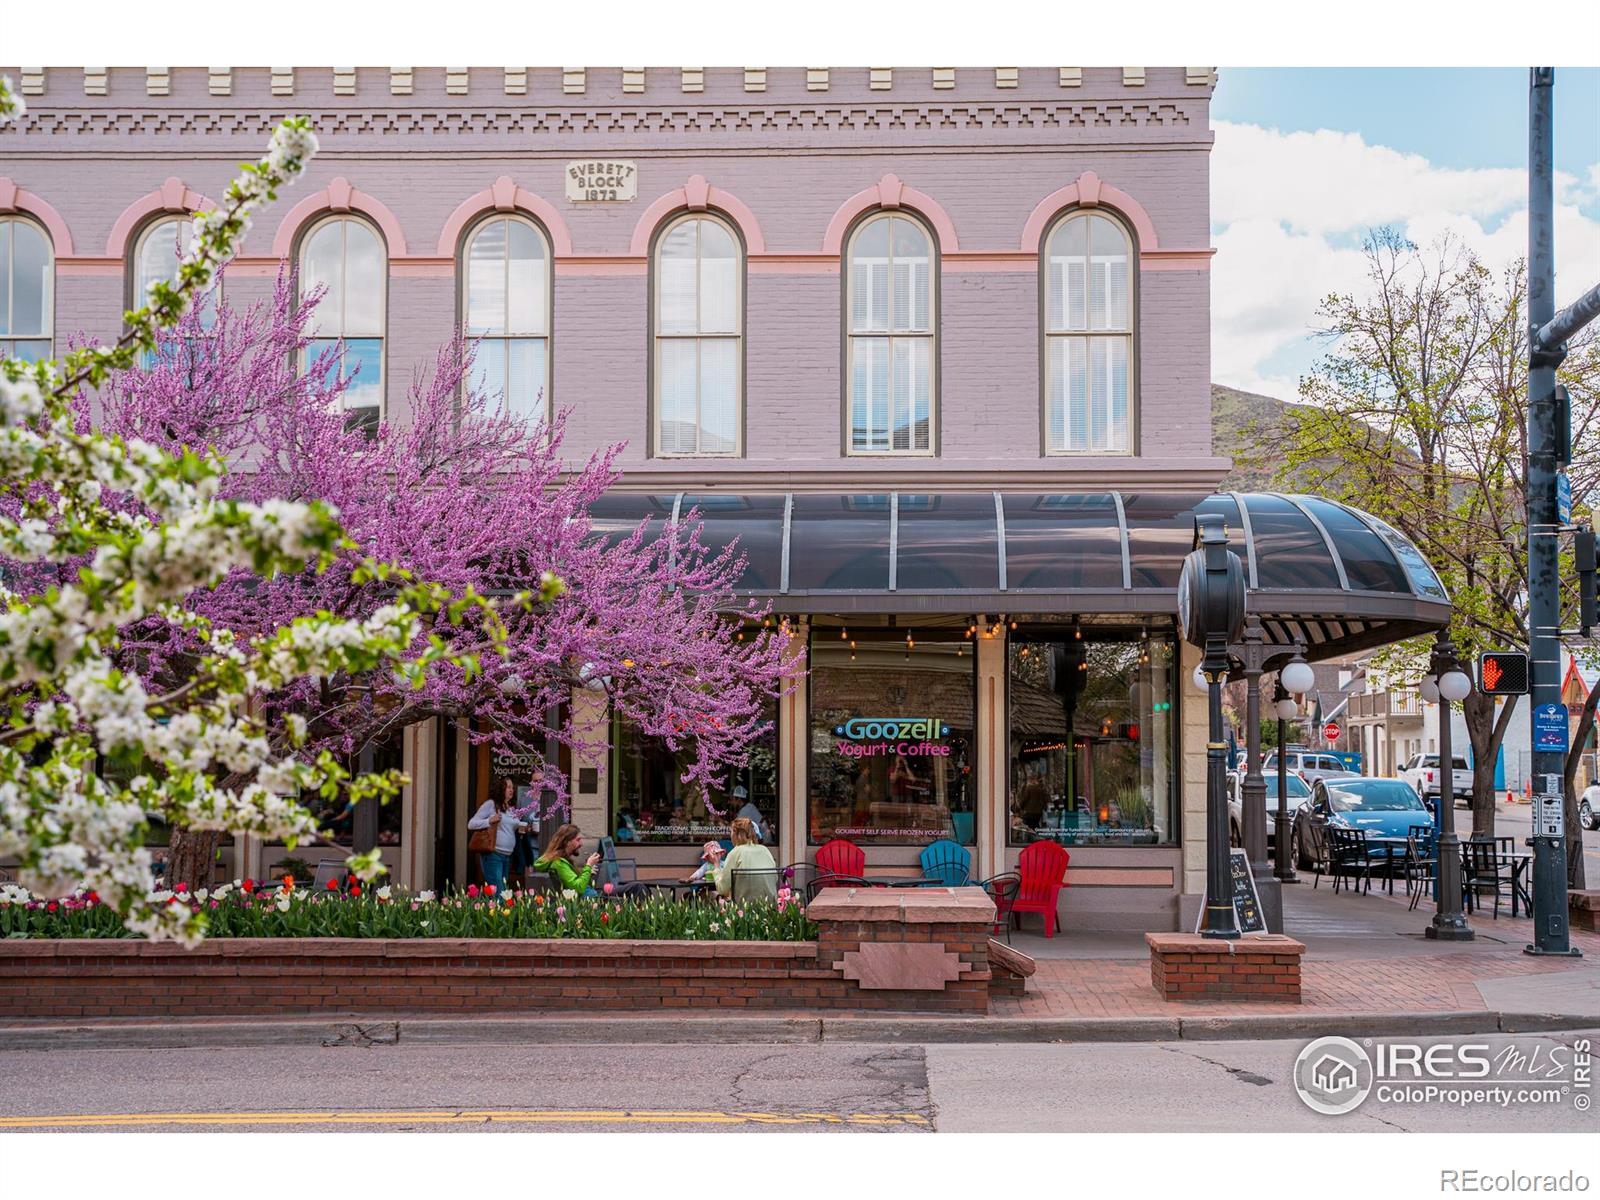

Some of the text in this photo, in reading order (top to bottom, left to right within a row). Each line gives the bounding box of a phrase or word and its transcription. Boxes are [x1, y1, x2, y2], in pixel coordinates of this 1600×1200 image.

[569, 162, 634, 179] EVERETT
[578, 176, 624, 188] BLOCK
[585, 190, 617, 201] 1873
[845, 718, 940, 739] Goozell
[837, 742, 950, 758] Yogurt & Coffee
